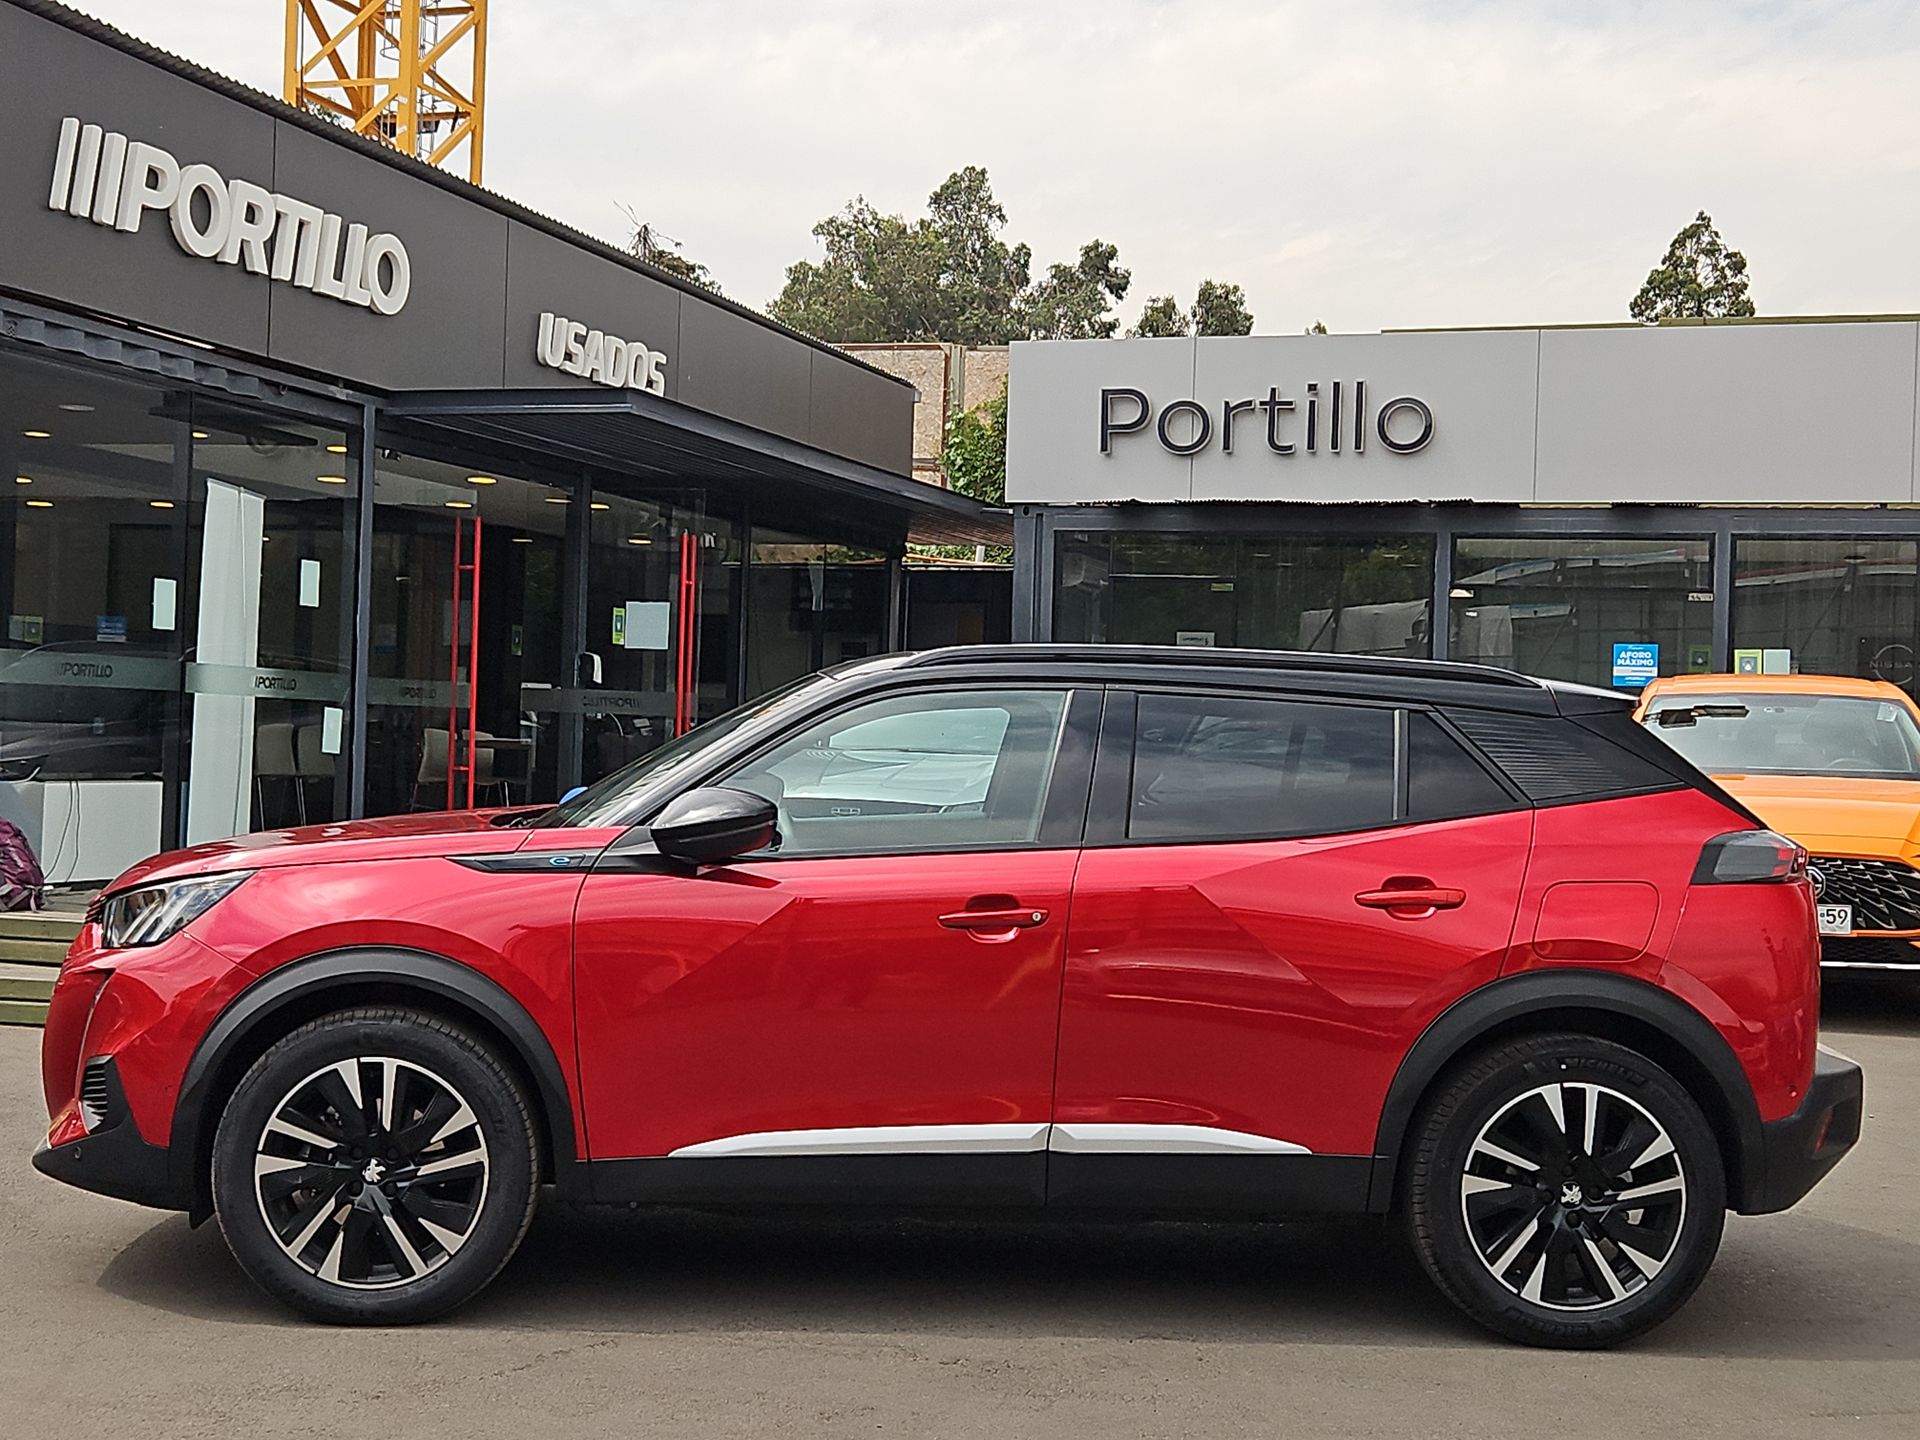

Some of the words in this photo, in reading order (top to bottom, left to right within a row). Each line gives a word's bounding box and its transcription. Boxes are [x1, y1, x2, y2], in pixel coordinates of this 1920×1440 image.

[536, 311, 667, 397] USADOS
[1099, 379, 1434, 456] Portillo
[1619, 651, 1652, 659] AFORO
